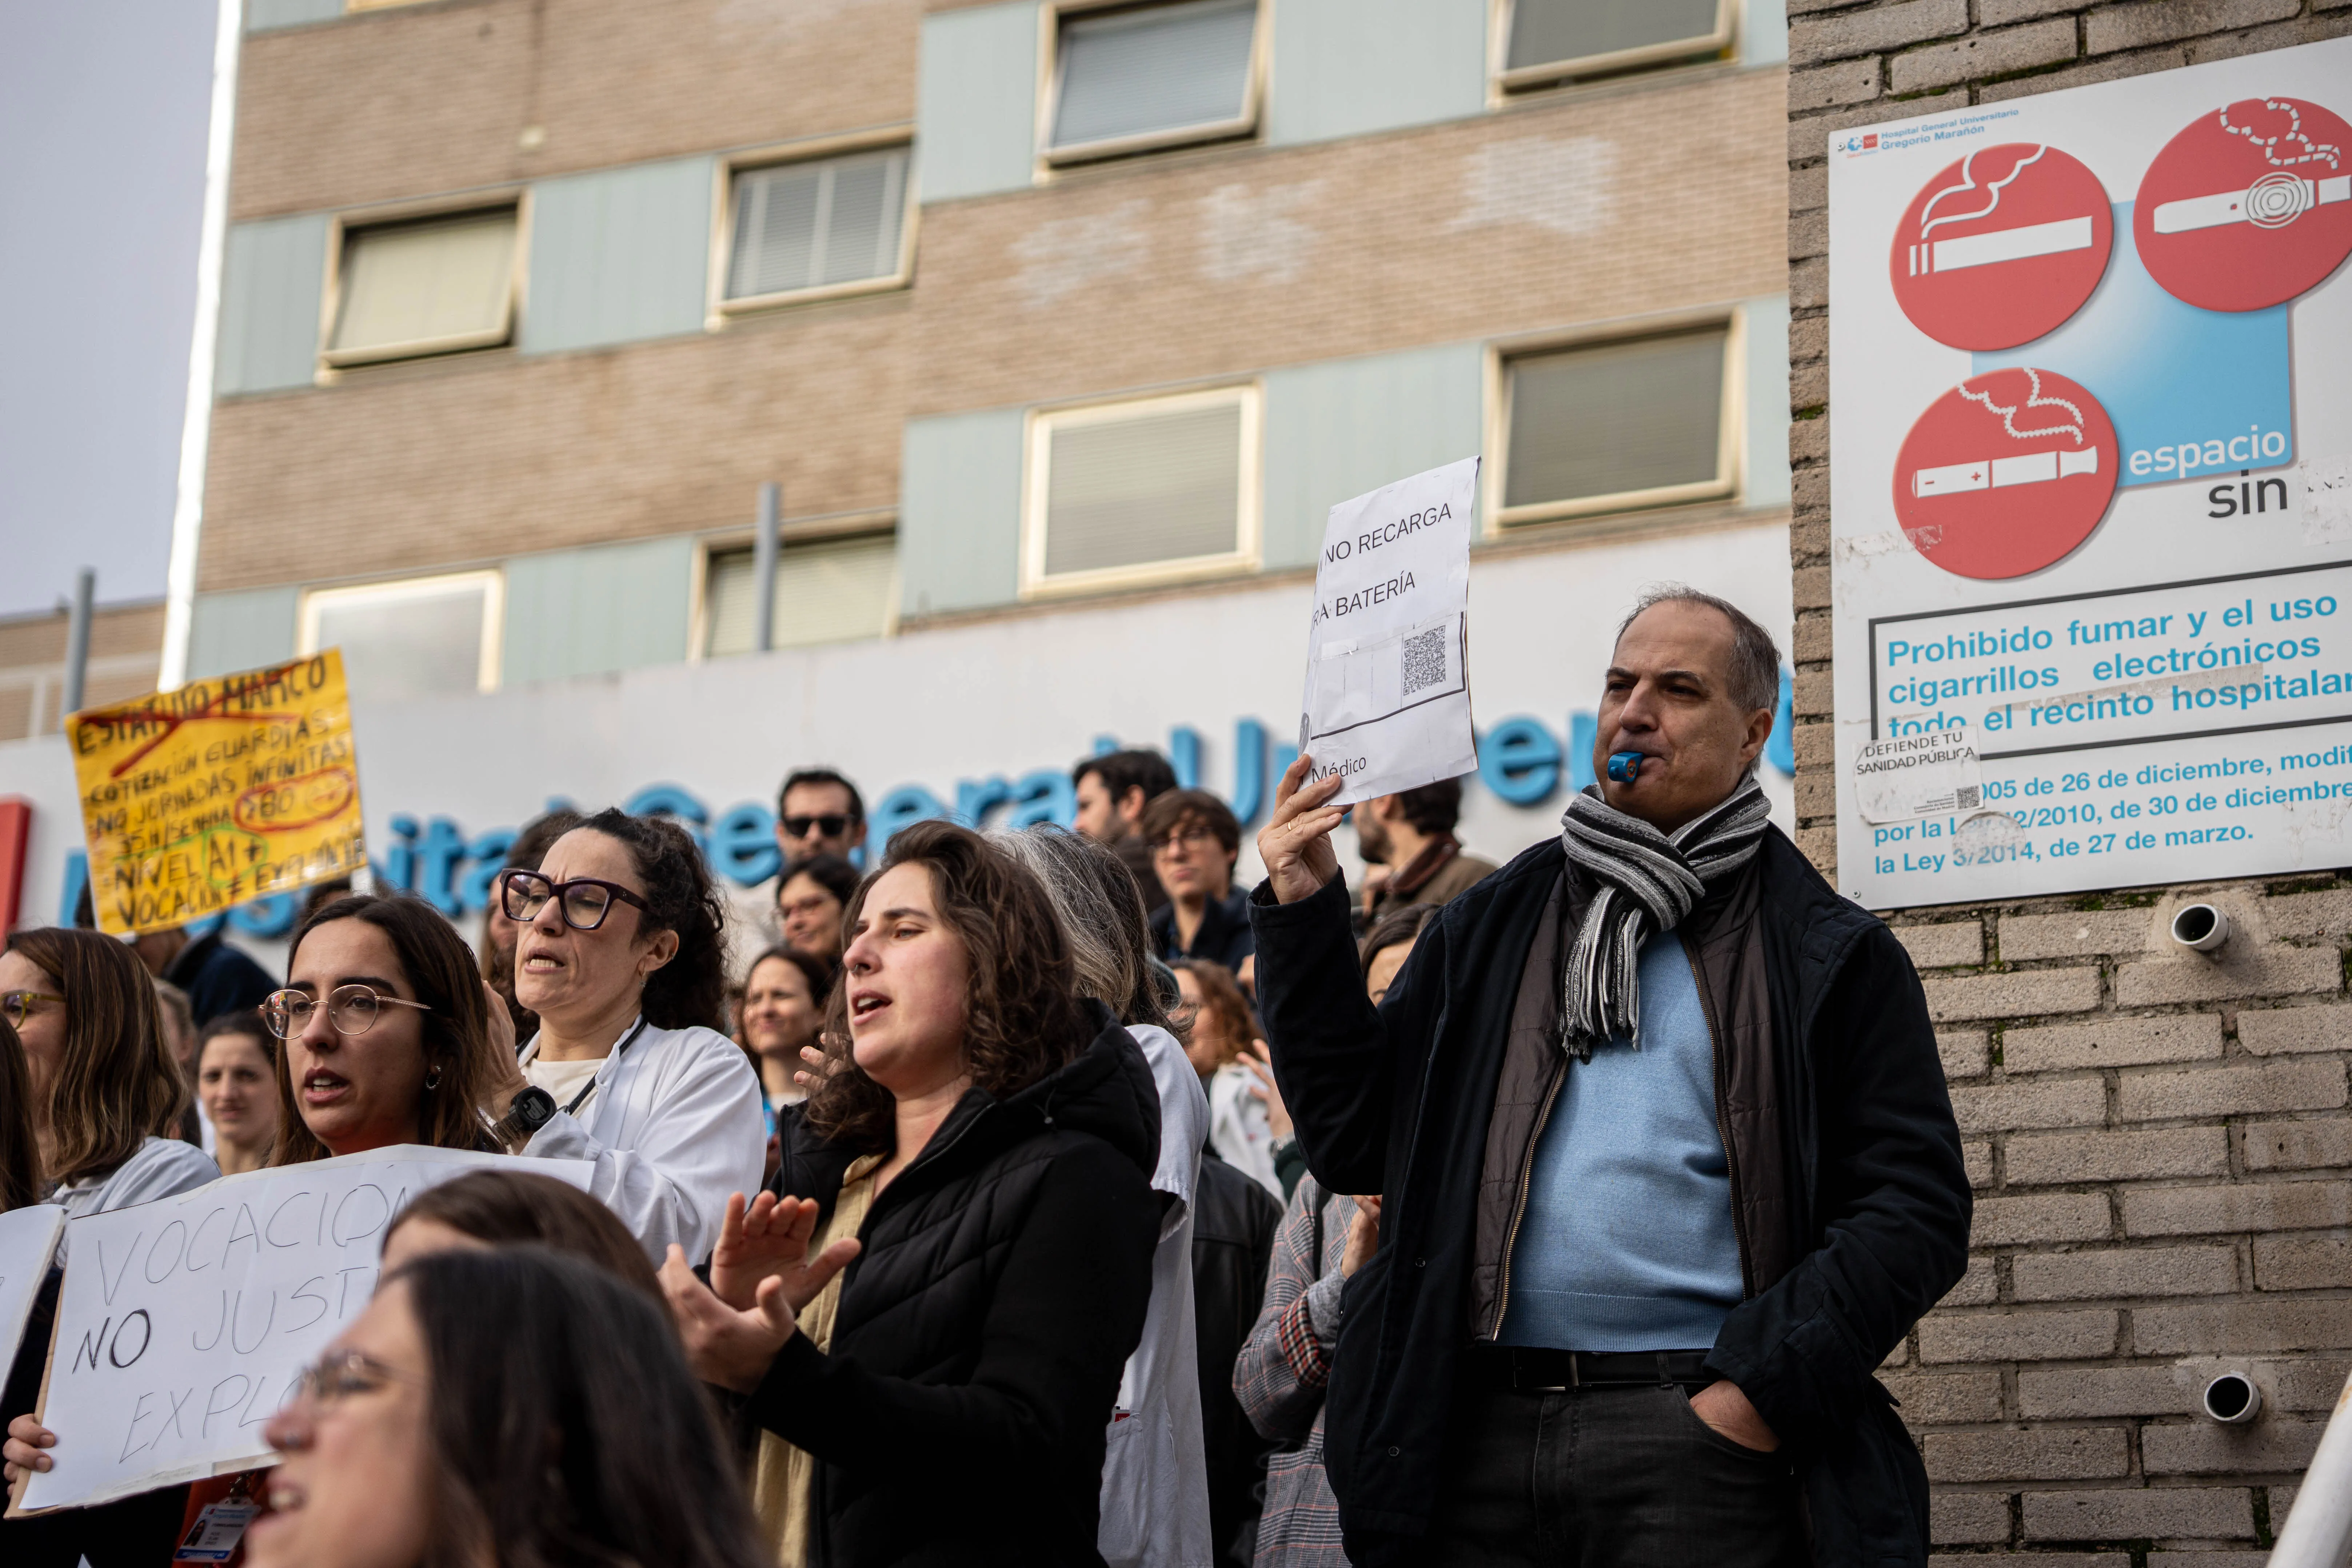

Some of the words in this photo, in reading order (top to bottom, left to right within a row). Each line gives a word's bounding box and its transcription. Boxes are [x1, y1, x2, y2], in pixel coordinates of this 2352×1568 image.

[1881, 126, 1918, 139] Hospital
[1921, 120, 1957, 132] General
[1960, 108, 2019, 125] Universitario
[1881, 135, 1930, 150] Gregorio
[1934, 125, 1985, 140] Marañón
[2129, 424, 2286, 479] espacio
[2208, 470, 2288, 519] sin
[1325, 541, 1351, 566] NO
[1359, 503, 1451, 554] RECARGA
[1336, 570, 1415, 617] BATERÍA
[1889, 626, 2053, 666] Prohibido
[2068, 614, 2173, 645] fumar
[2187, 611, 2207, 638] y
[2223, 599, 2253, 627] el
[2270, 595, 2337, 622] uso
[220, 657, 326, 713] MARCO
[1889, 665, 2059, 706] cigarrillos
[2093, 637, 2320, 681] electrónicos
[1984, 703, 2012, 731] el
[2031, 691, 2154, 726] recinto
[1857, 755, 1916, 775] SANIDAD
[1919, 746, 1975, 765] PÚBLICA
[1865, 735, 1939, 757] DEFIENDE
[1942, 731, 1963, 744] TU
[1311, 757, 1366, 784] Médico
[2024, 777, 2054, 796] de
[2061, 772, 2091, 793] 26
[2098, 769, 2128, 789] de
[2136, 757, 2272, 785] diciembre,
[1874, 824, 1915, 847] por
[1922, 819, 1941, 838] la
[2111, 800, 2141, 820] de
[2148, 794, 2179, 815] 30
[2186, 793, 2217, 813] de
[1875, 855, 1895, 874] la
[1904, 853, 1946, 873] Ley
[1953, 841, 2041, 867] 3/2014,
[2049, 838, 2080, 857] de
[2088, 833, 2117, 854] 27
[2125, 831, 2156, 850] de
[2165, 825, 2253, 847] marzo.
[72, 1308, 153, 1374] NO
